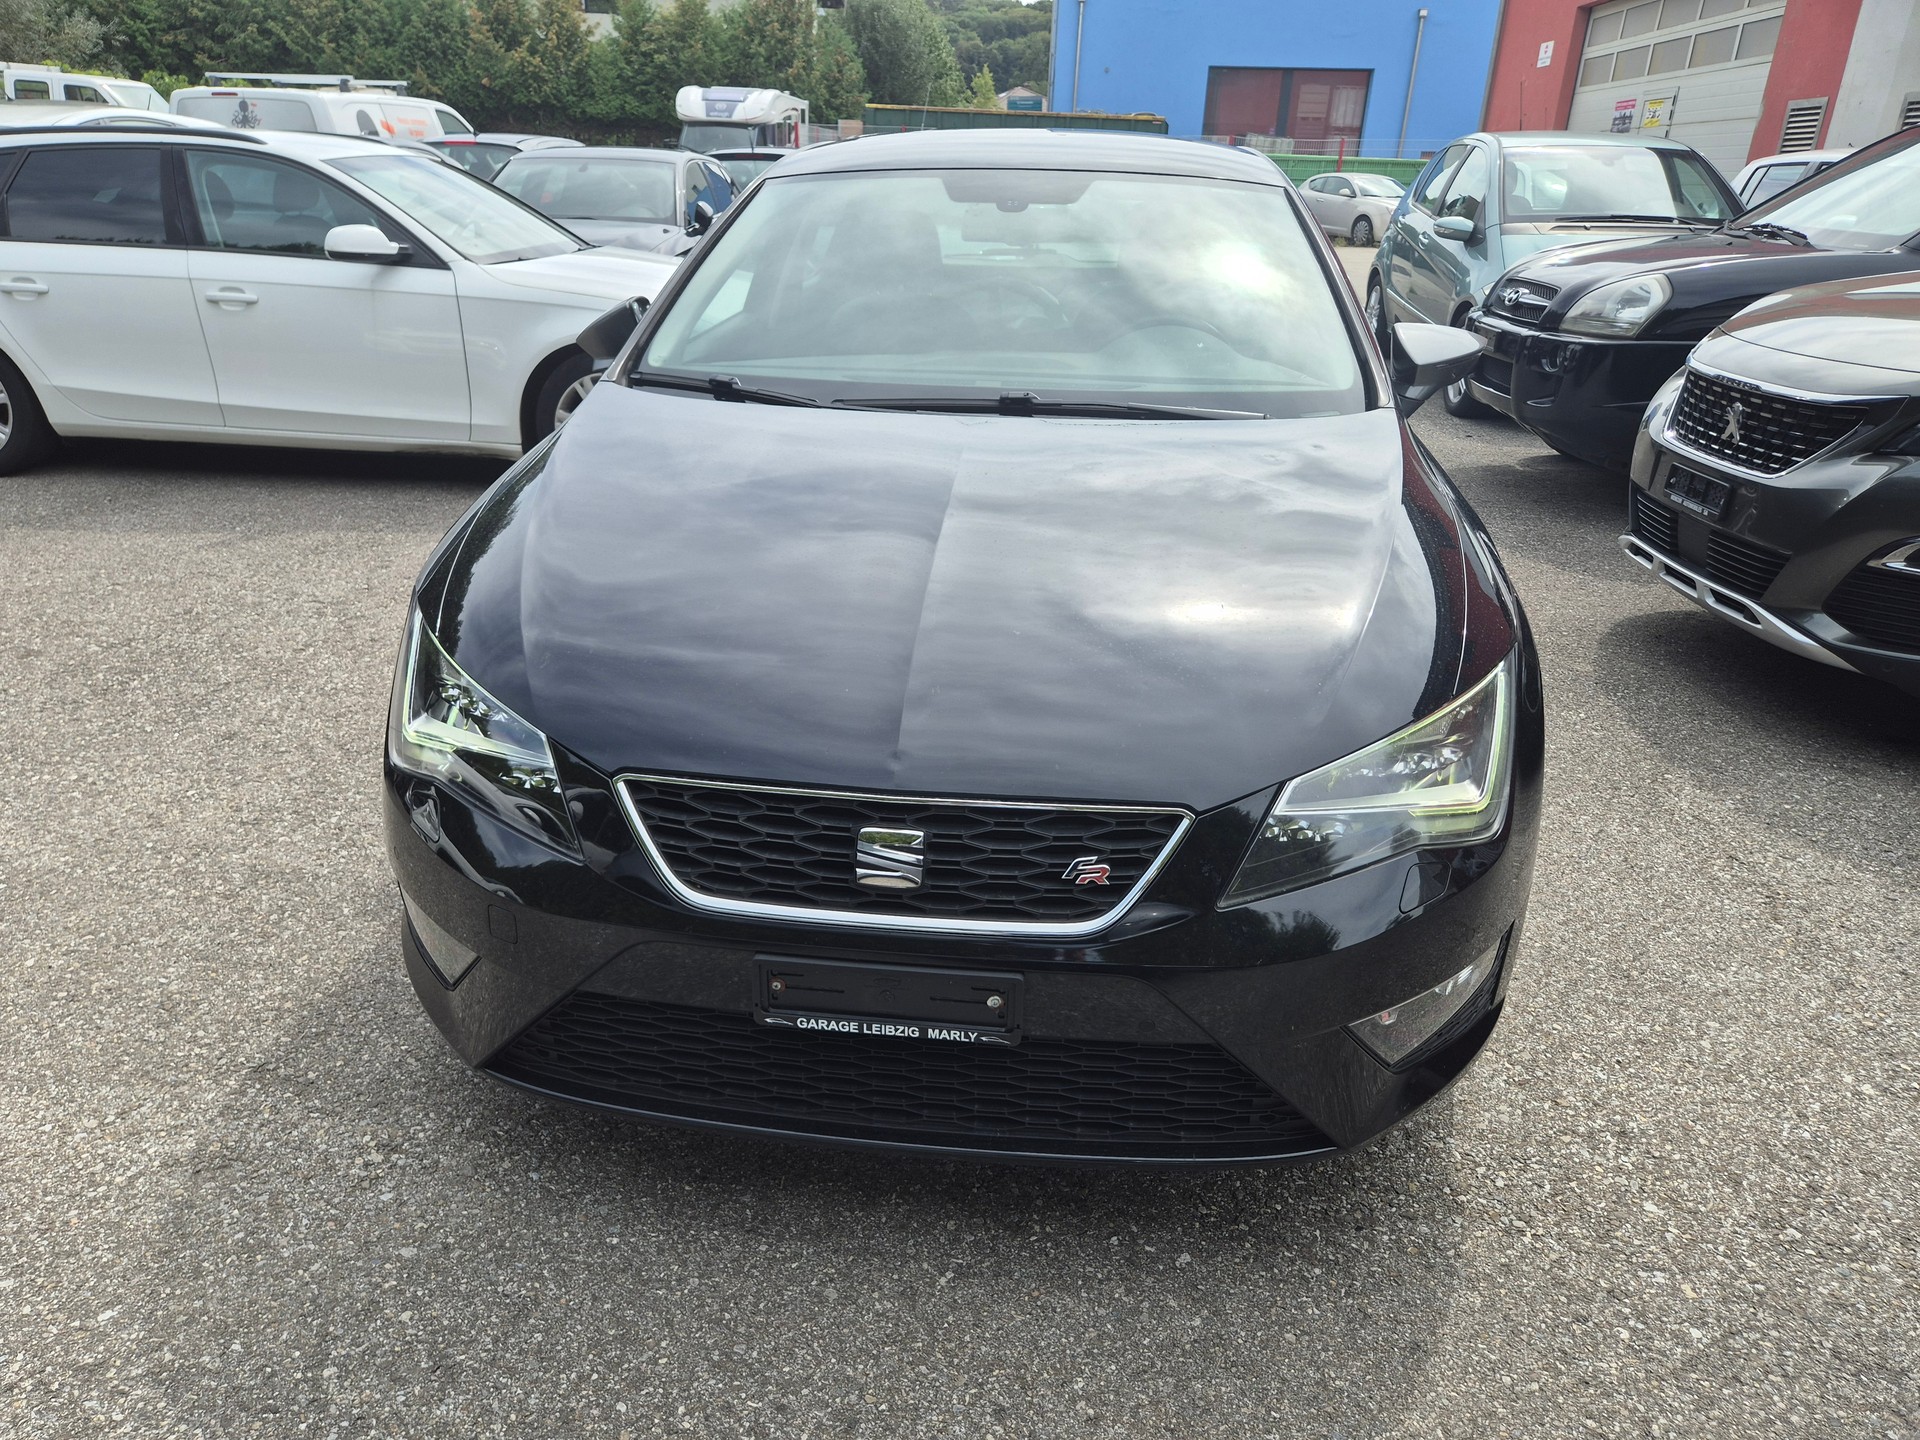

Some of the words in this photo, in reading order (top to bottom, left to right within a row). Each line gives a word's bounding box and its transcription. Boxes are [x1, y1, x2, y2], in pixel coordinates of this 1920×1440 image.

[1061, 855, 1110, 885] FR
[796, 1017, 859, 1033] GARAGE
[863, 1023, 920, 1038] LEIBZIG
[927, 1028, 978, 1042] MARLY
